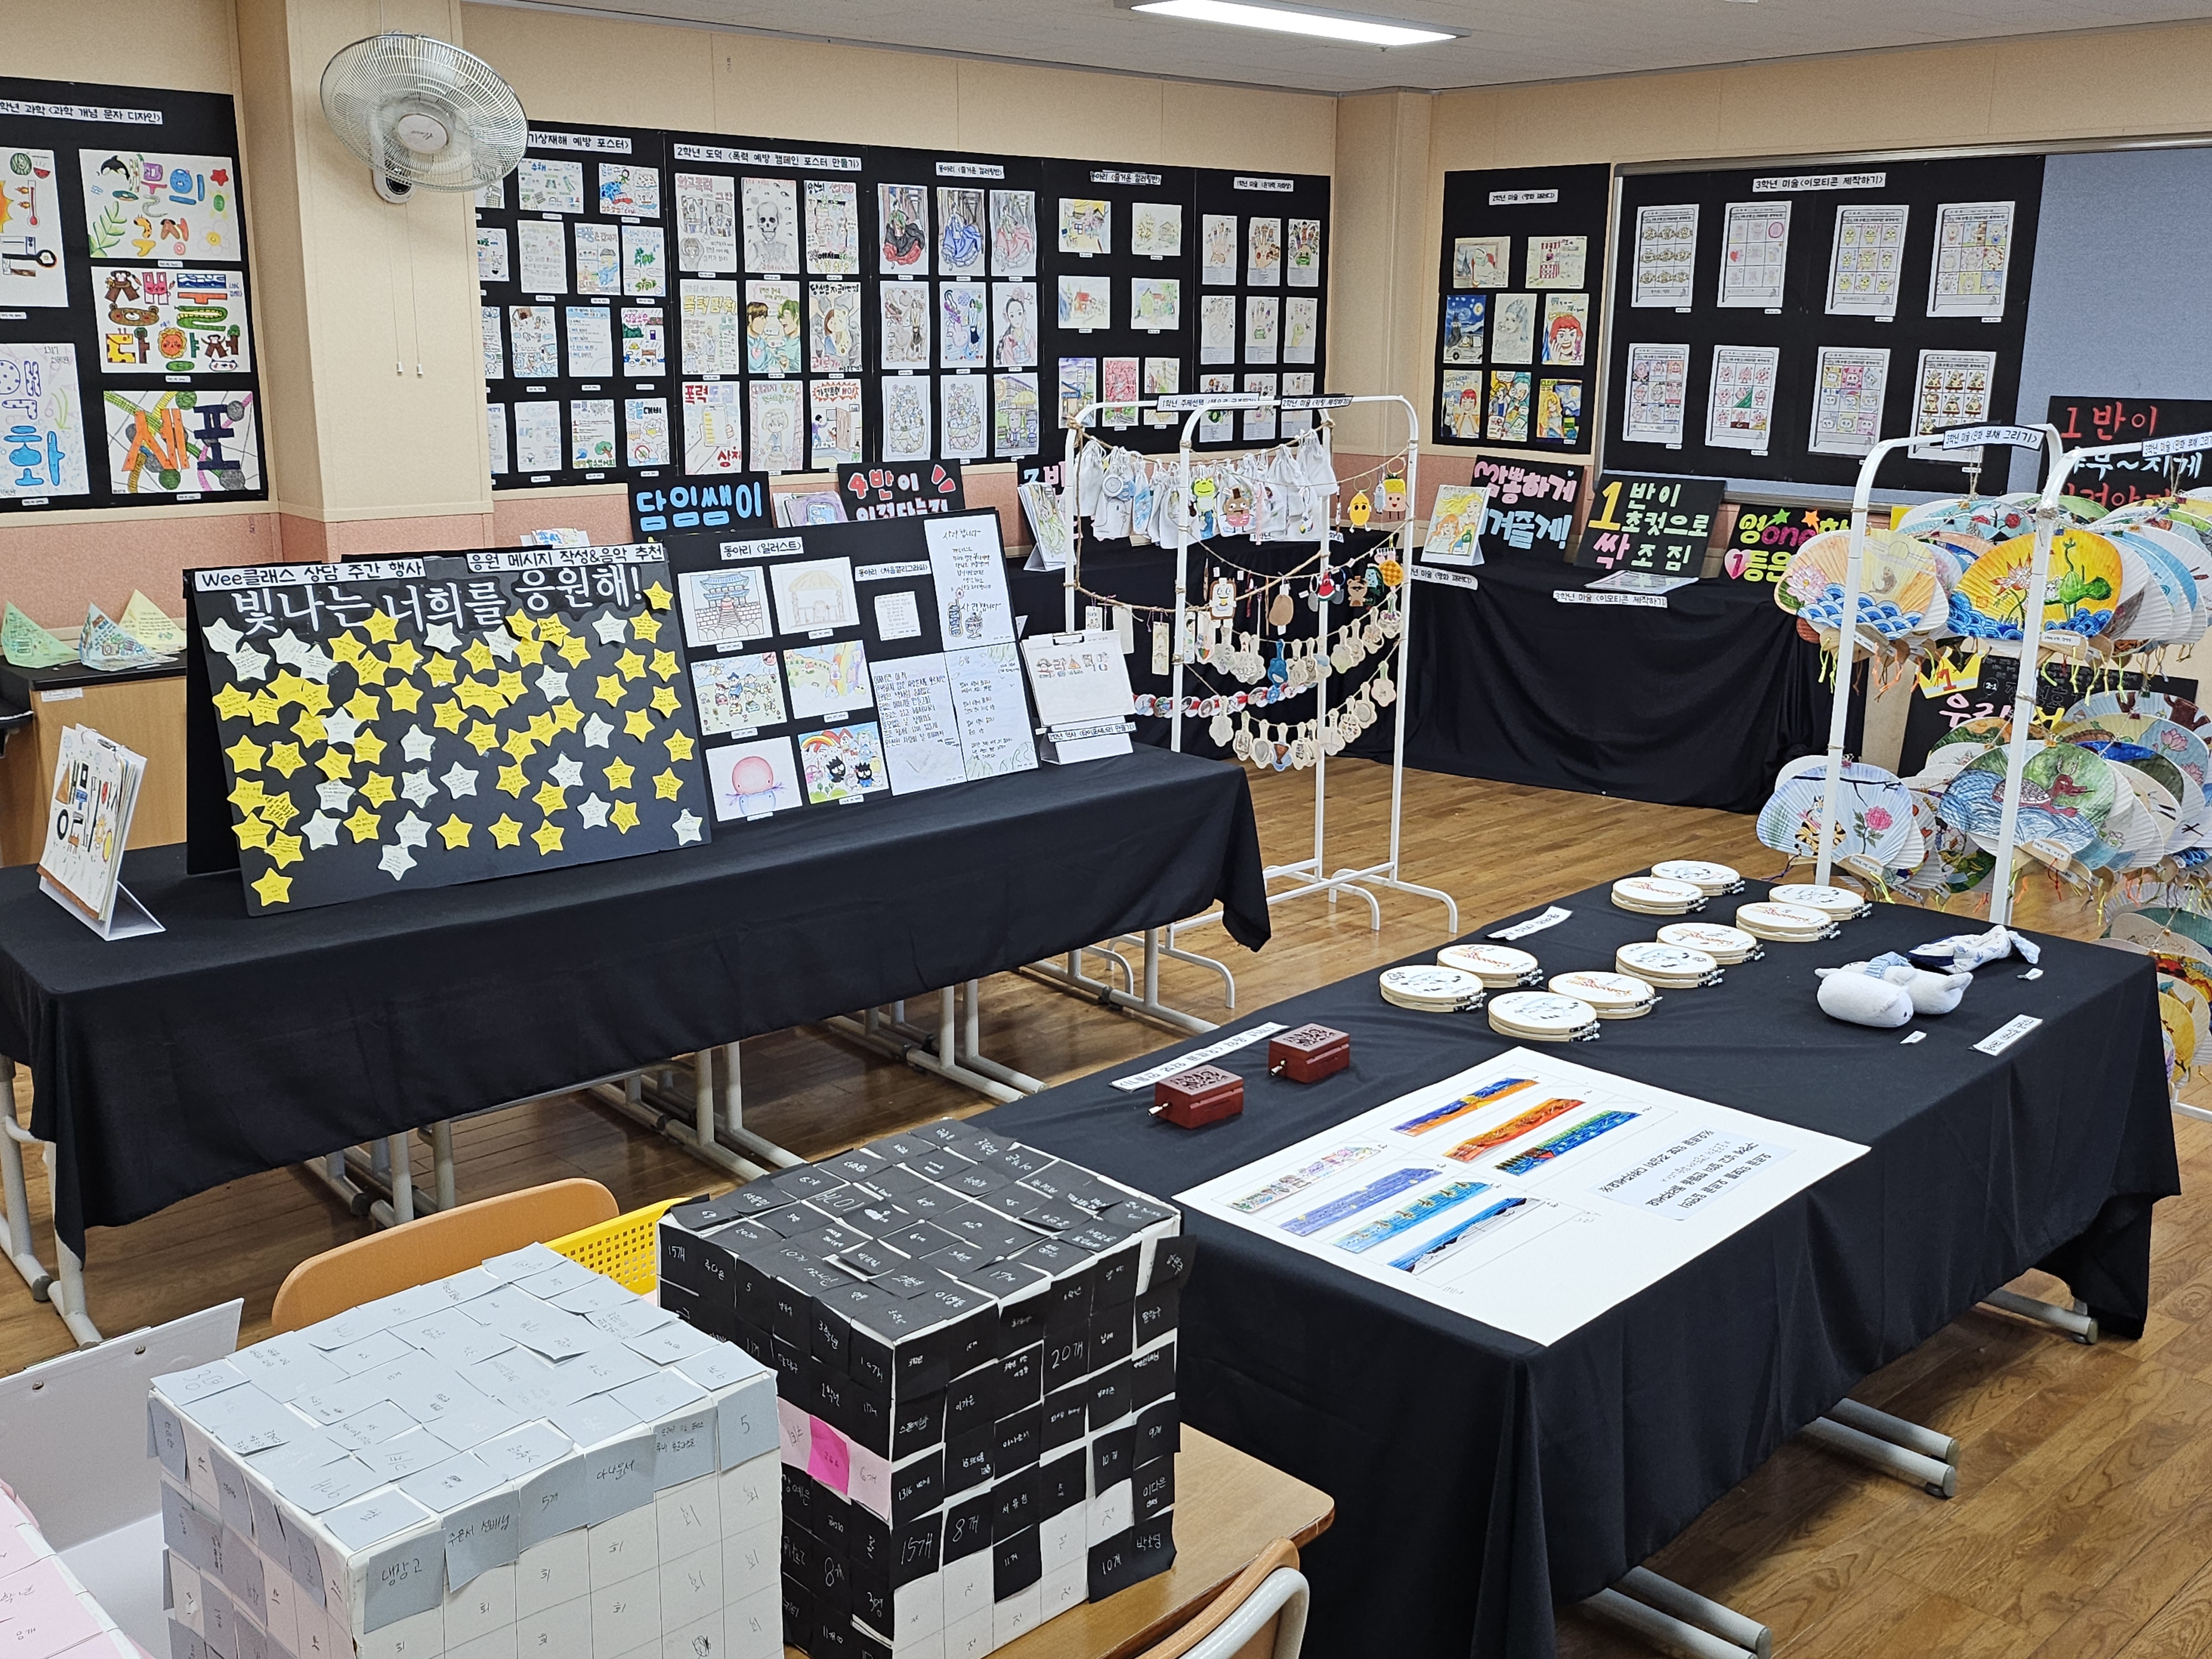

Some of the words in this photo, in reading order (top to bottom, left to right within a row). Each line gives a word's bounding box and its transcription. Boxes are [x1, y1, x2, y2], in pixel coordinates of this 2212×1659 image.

[25, 104, 45, 115] 과학
[78, 108, 98, 118] 개념
[104, 109, 123, 119] 문자
[128, 112, 161, 122] 디자인>
[573, 137, 592, 147] 예방
[597, 138, 629, 149] 포스터>
[677, 147, 700, 158] 2학년
[706, 149, 722, 160] 도덕
[728, 151, 749, 162] <폭력
[754, 153, 770, 163] 예방
[774, 154, 799, 165] 캠페인
[804, 157, 828, 166] 포스터
[1755, 180, 1778, 190] 3학년
[1782, 178, 1799, 189] 미술
[1800, 176, 1838, 187] <이모티콘
[1843, 175, 1884, 186] 제작하기>
[1985, 430, 2000, 439] 부채
[2002, 430, 2037, 443] 그리기>
[848, 469, 919, 500] 4반이
[1621, 509, 1710, 538] 초컷으로
[472, 553, 499, 572] 응원
[508, 550, 552, 568] 메시지
[559, 546, 628, 566] 작성&음악
[636, 544, 663, 562] 추천
[724, 546, 752, 558] 동아리
[757, 542, 801, 554] <일러스트>
[202, 567, 295, 588] Wee클래스
[304, 562, 339, 584] 상담
[347, 561, 383, 581] 주간
[389, 560, 422, 578] 행사
[859, 568, 877, 576] 동아리
[232, 587, 375, 634] 빛나는
[385, 581, 507, 632] 너희를
[515, 565, 643, 612] 응원해!
[1555, 592, 1575, 601] 3학년
[1665, 1145, 1688, 1155] 악보
[1642, 1154, 1672, 1168] 조심히
[1051, 1340, 1083, 1369] 20개
[952, 1515, 979, 1543] 8개
[1102, 1555, 1121, 1575] 10개
